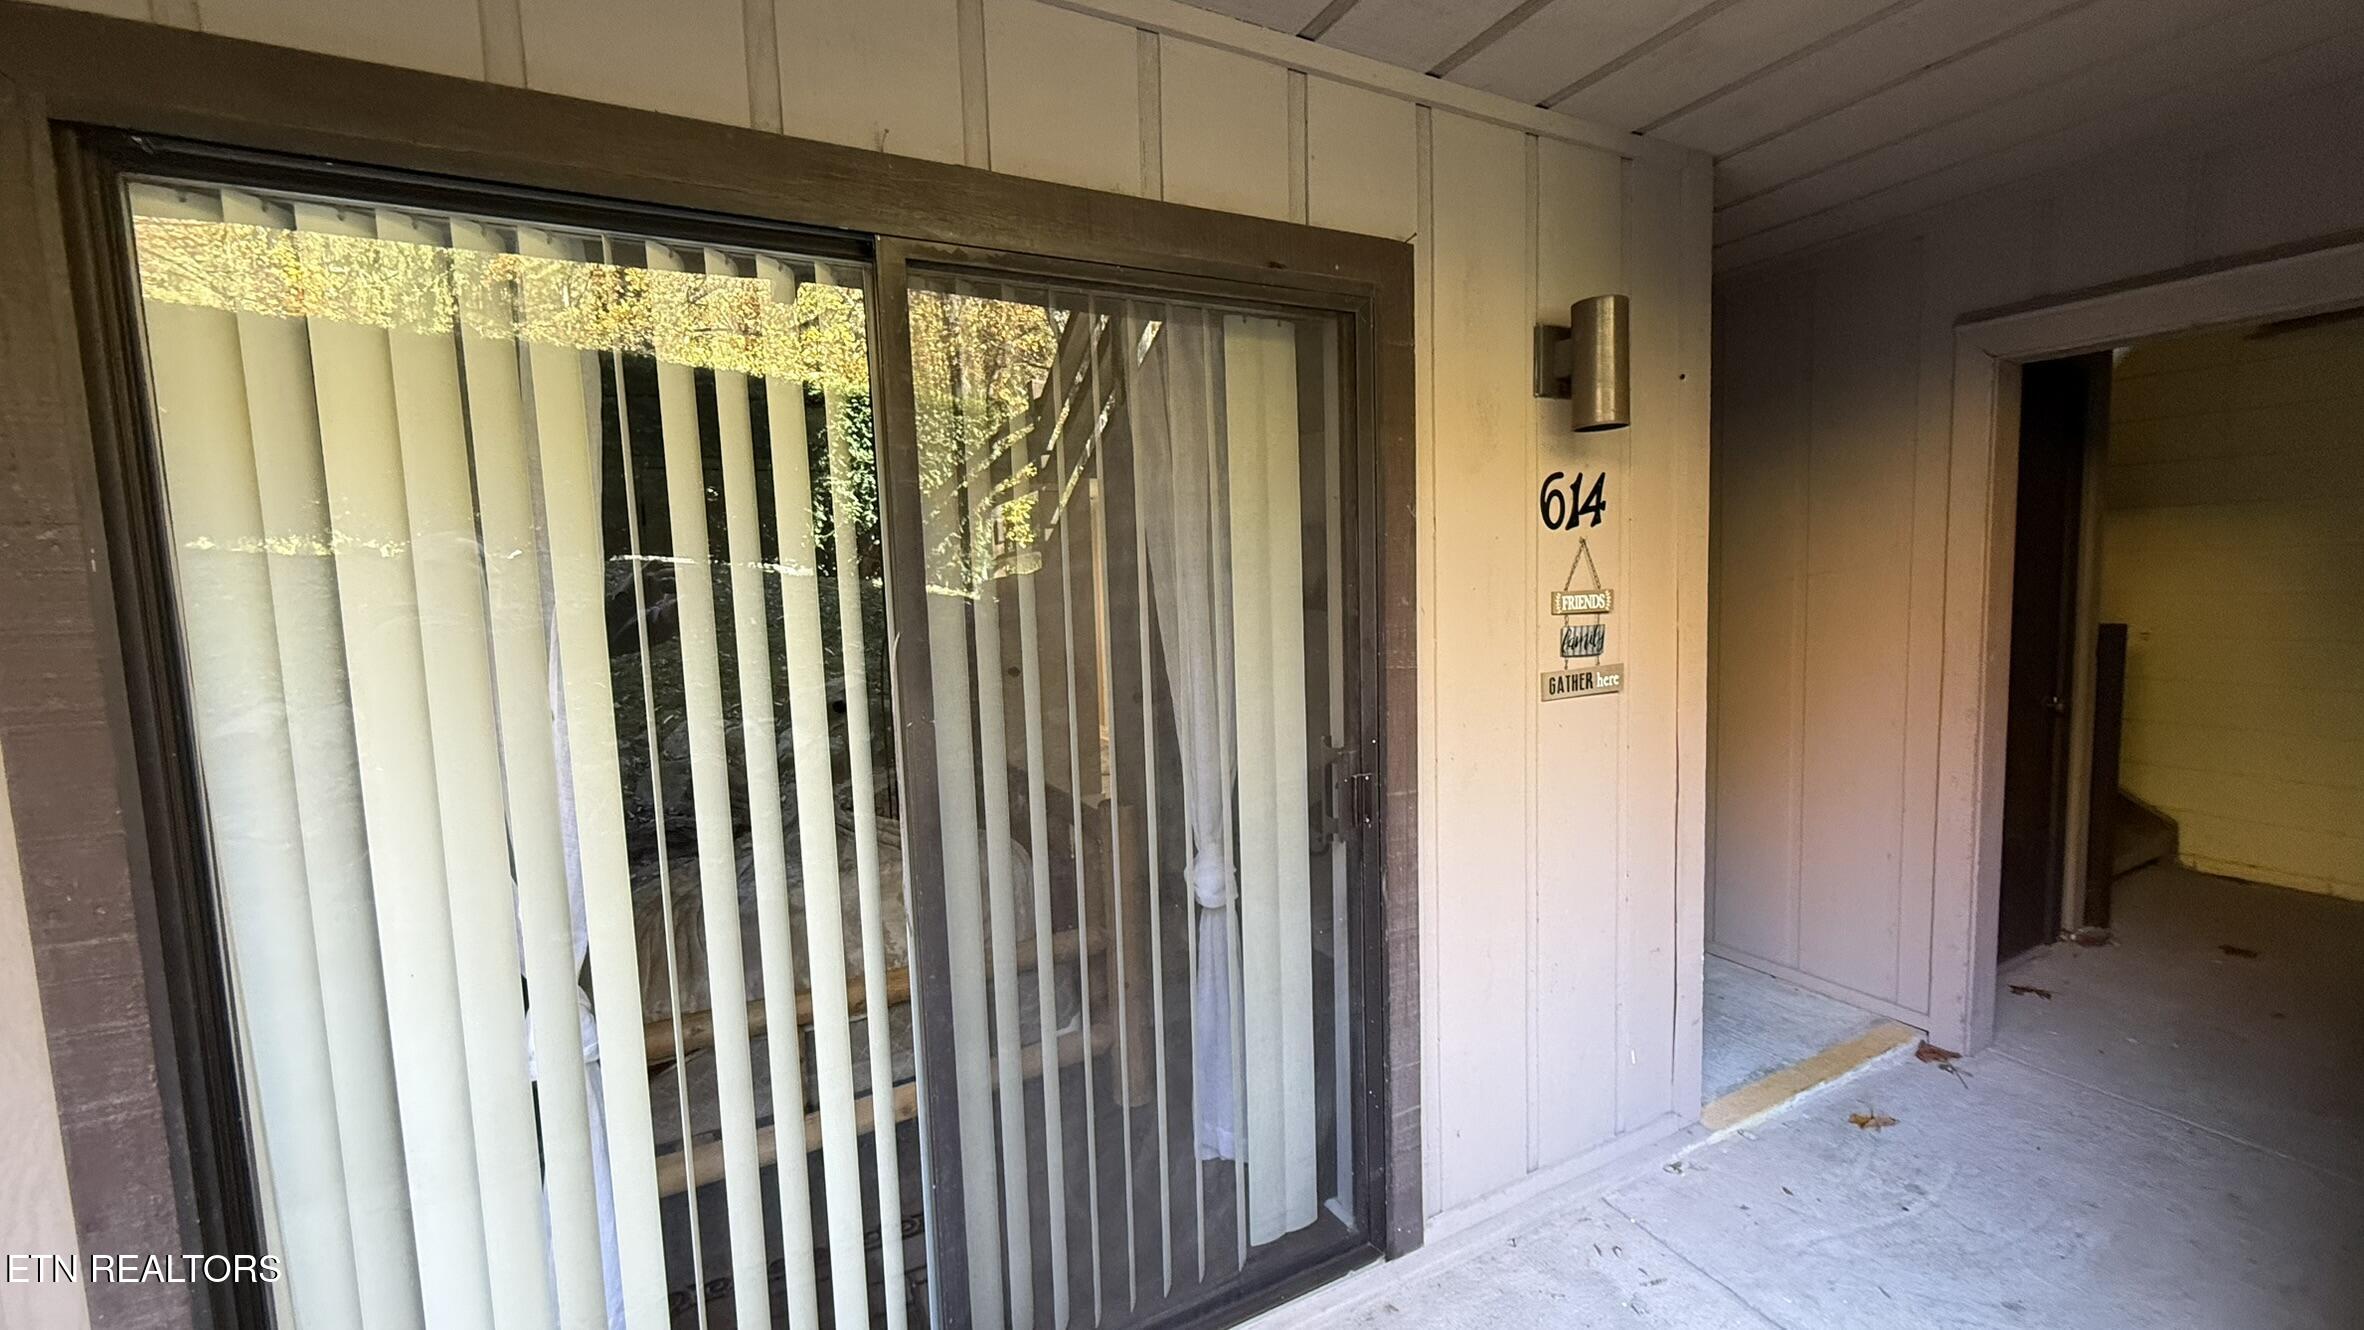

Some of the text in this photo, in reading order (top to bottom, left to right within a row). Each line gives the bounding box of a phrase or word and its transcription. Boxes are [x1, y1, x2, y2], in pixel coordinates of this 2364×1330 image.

[1540, 471, 1606, 531] 614
[1561, 593, 1606, 611] FRIENDS
[1548, 672, 1620, 695] GATHER here
